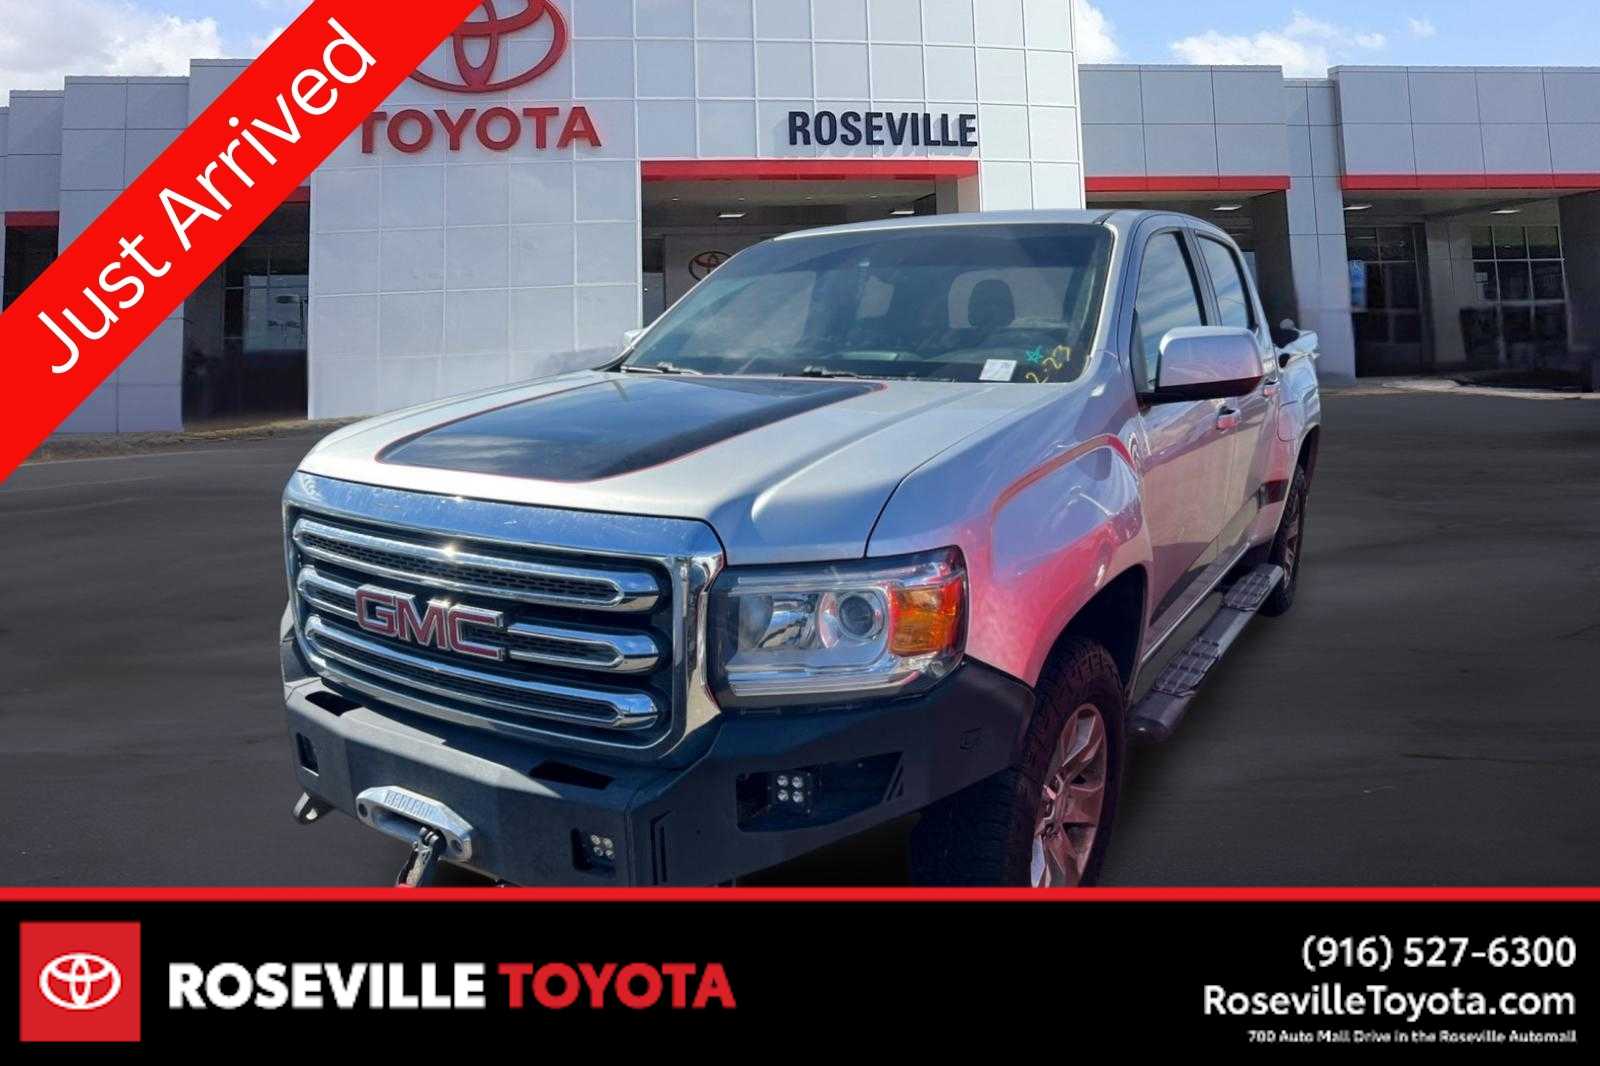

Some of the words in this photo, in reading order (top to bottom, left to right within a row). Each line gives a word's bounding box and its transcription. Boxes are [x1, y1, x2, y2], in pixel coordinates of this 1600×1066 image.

[361, 106, 602, 154] TOYOTA
[788, 110, 978, 147] ROSEVILLE
[355, 584, 505, 662] GMC
